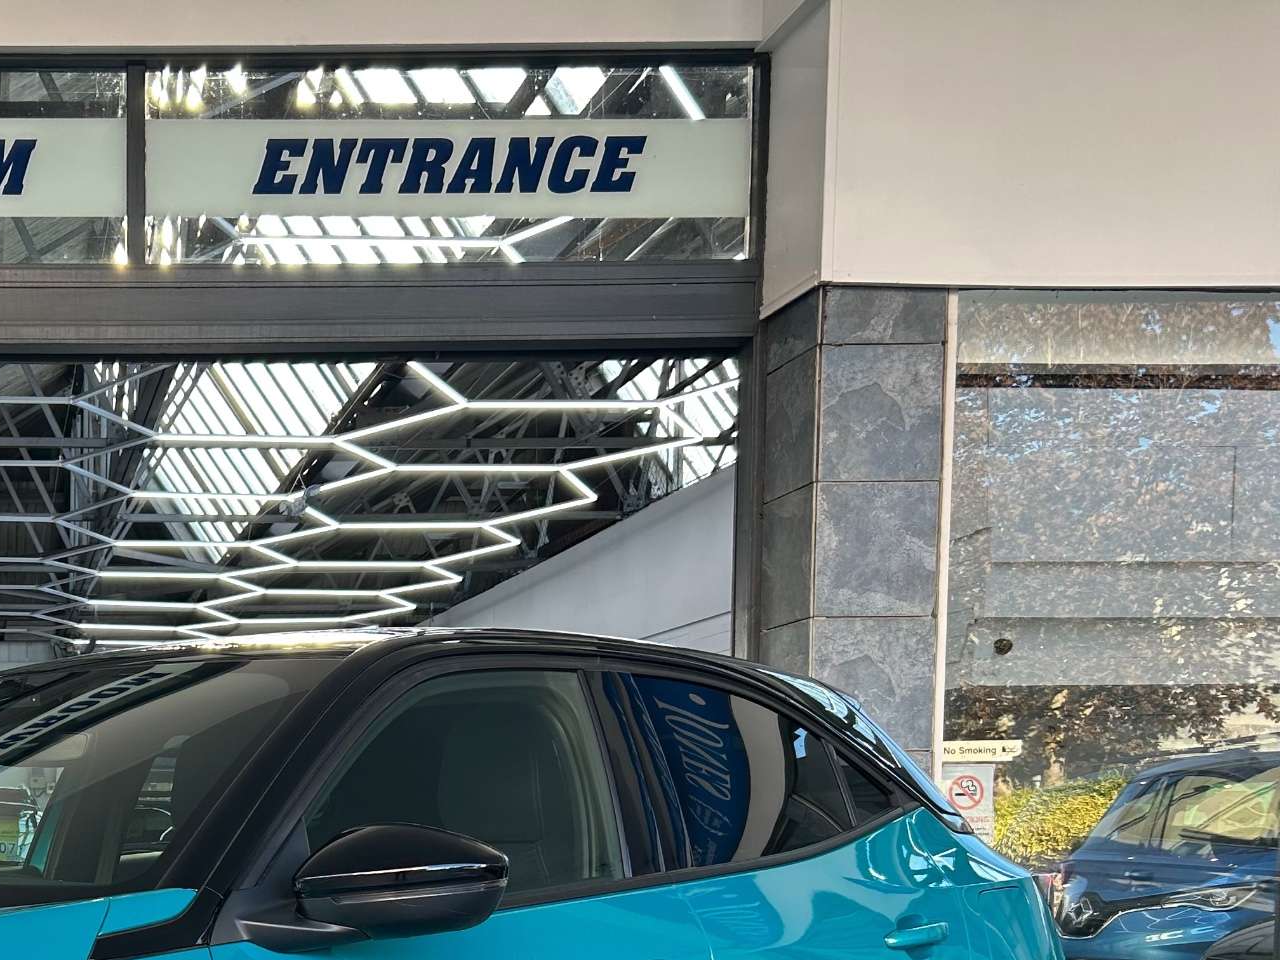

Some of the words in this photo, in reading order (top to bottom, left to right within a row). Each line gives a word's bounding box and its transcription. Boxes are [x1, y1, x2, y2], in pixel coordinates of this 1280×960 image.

[252, 134, 648, 196] ENTRANCE
[943, 747, 956, 755] No
[959, 746, 997, 756] Smoking
